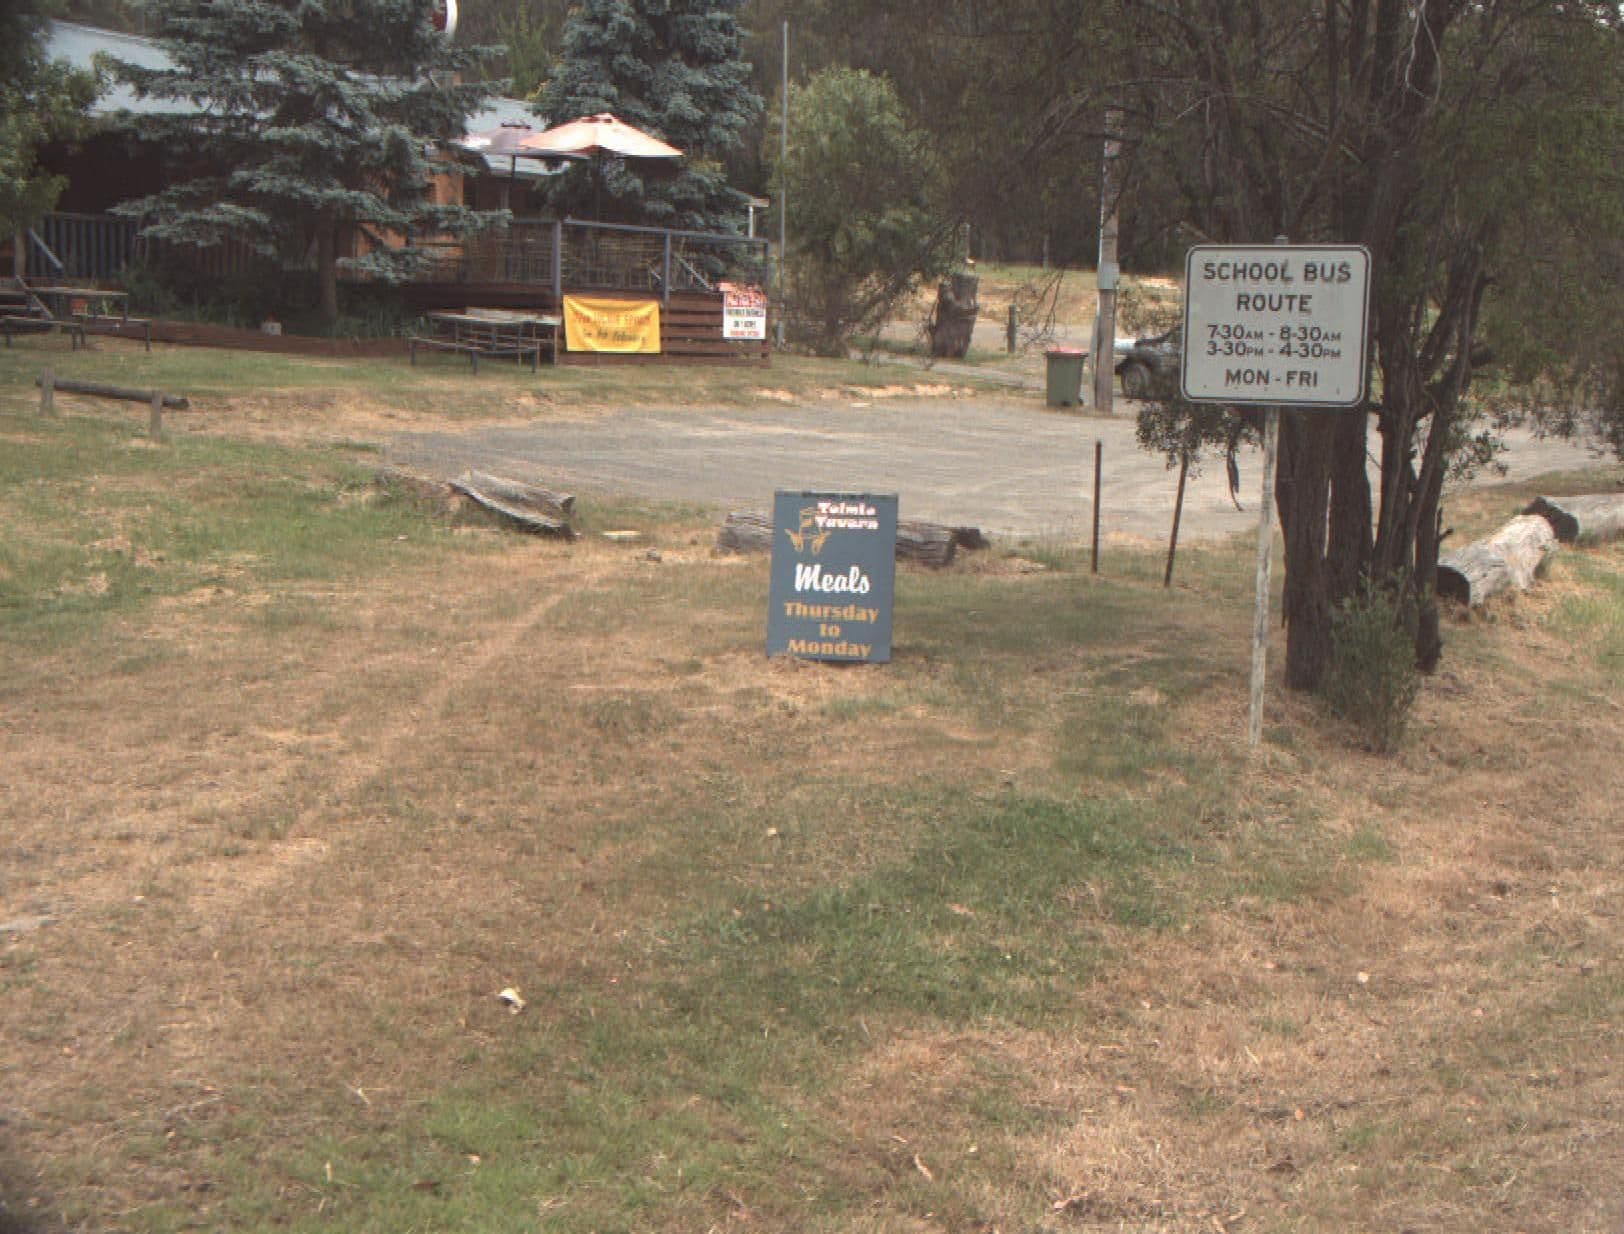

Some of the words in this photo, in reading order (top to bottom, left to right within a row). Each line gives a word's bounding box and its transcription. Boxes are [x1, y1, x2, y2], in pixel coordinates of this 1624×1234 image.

[1203, 262, 1293, 282] SCHOOL
[1303, 262, 1352, 283] BUS
[1236, 294, 1313, 312] ROUTE
[1224, 368, 1270, 386] MON
[1286, 370, 1318, 387] FRI
[815, 515, 879, 529] Tavern
[794, 563, 870, 594] Meals
[784, 602, 879, 624] Thursday
[820, 623, 841, 637] to
[787, 639, 872, 657] Monday
